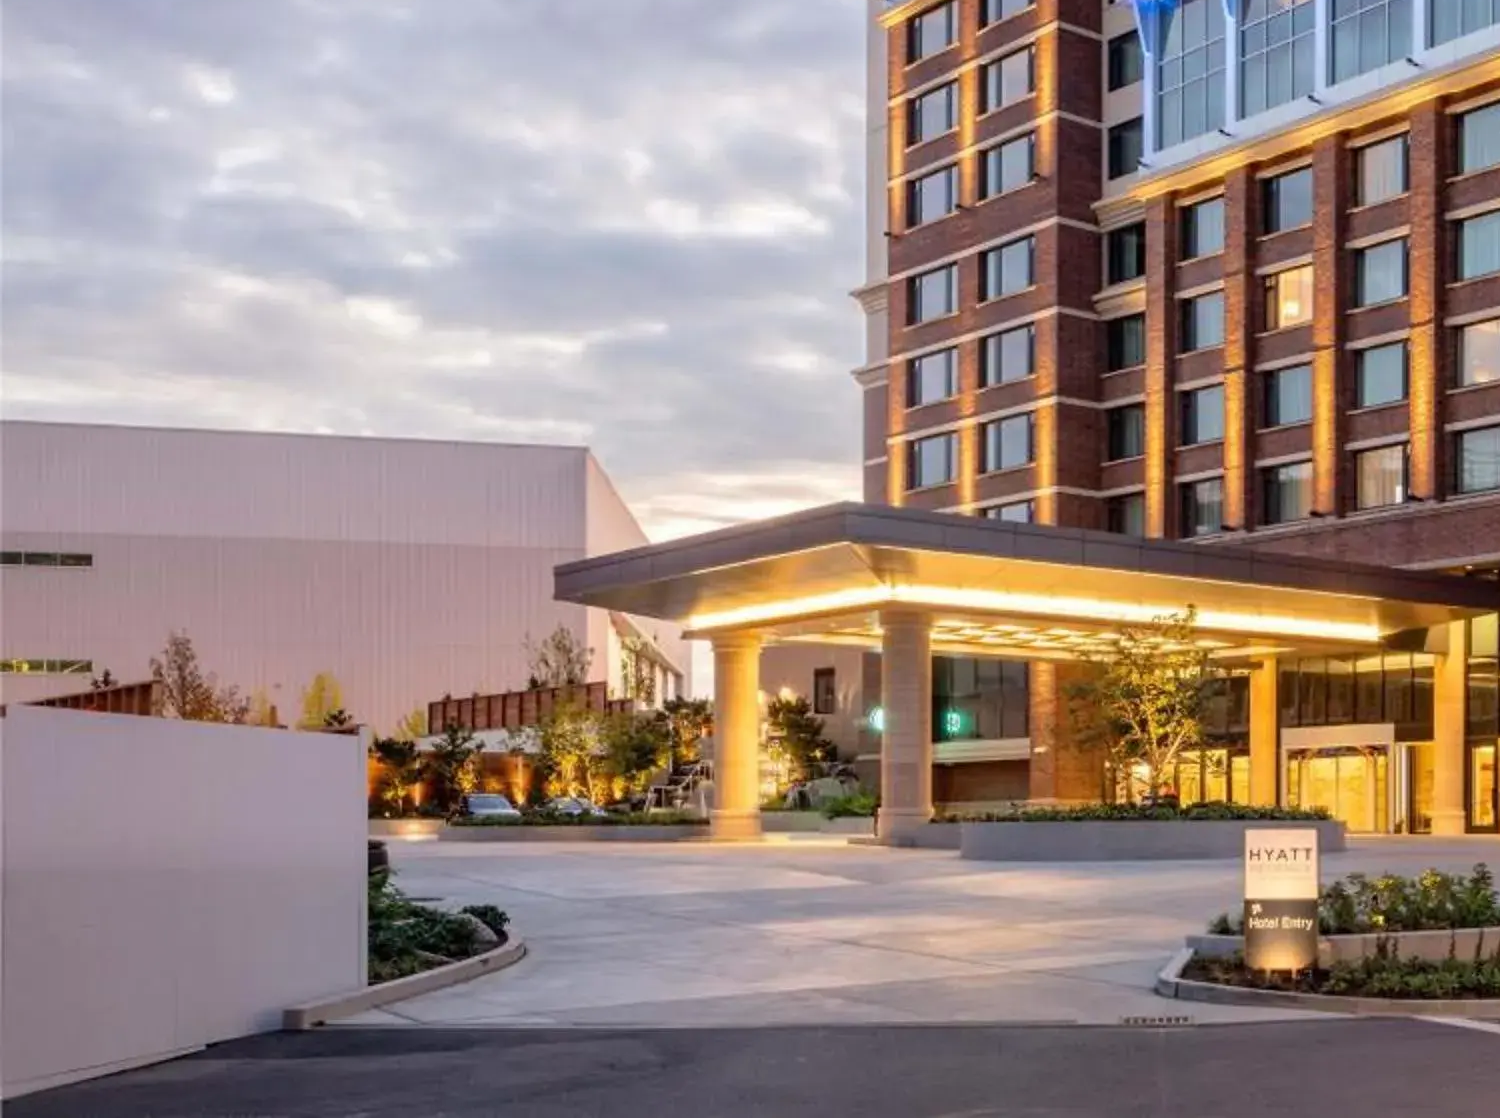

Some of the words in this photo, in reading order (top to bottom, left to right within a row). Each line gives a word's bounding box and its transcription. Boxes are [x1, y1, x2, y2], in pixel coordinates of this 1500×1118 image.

[1248, 847, 1313, 862] HYATT
[1248, 916, 1280, 930] Hotel
[1281, 916, 1314, 932] Entry
